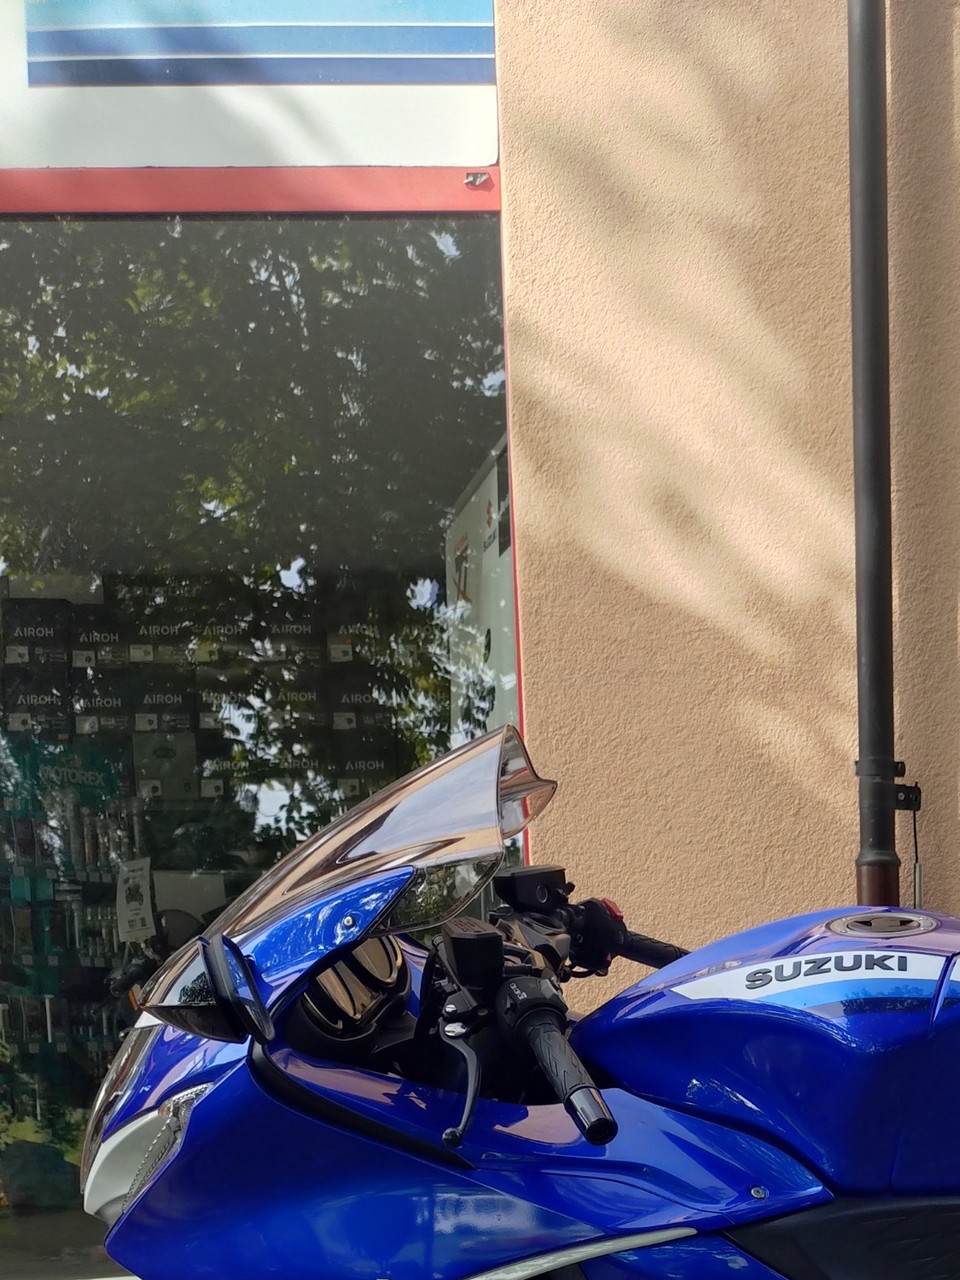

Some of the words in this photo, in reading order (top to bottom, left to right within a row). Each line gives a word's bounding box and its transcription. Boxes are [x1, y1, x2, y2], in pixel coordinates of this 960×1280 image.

[14, 627, 54, 638] AIROH
[138, 625, 179, 636] AIROH
[203, 625, 243, 636] AIROH
[270, 624, 311, 635] AIROH
[79, 632, 119, 643] AIROH
[17, 694, 57, 705] AIROH
[83, 697, 121, 707] AIROH
[143, 694, 182, 705] AIROH
[277, 692, 317, 702] AIROH
[280, 759, 319, 770] AIROH
[345, 760, 384, 771] AIROH
[745, 954, 908, 990] SUZUKI
